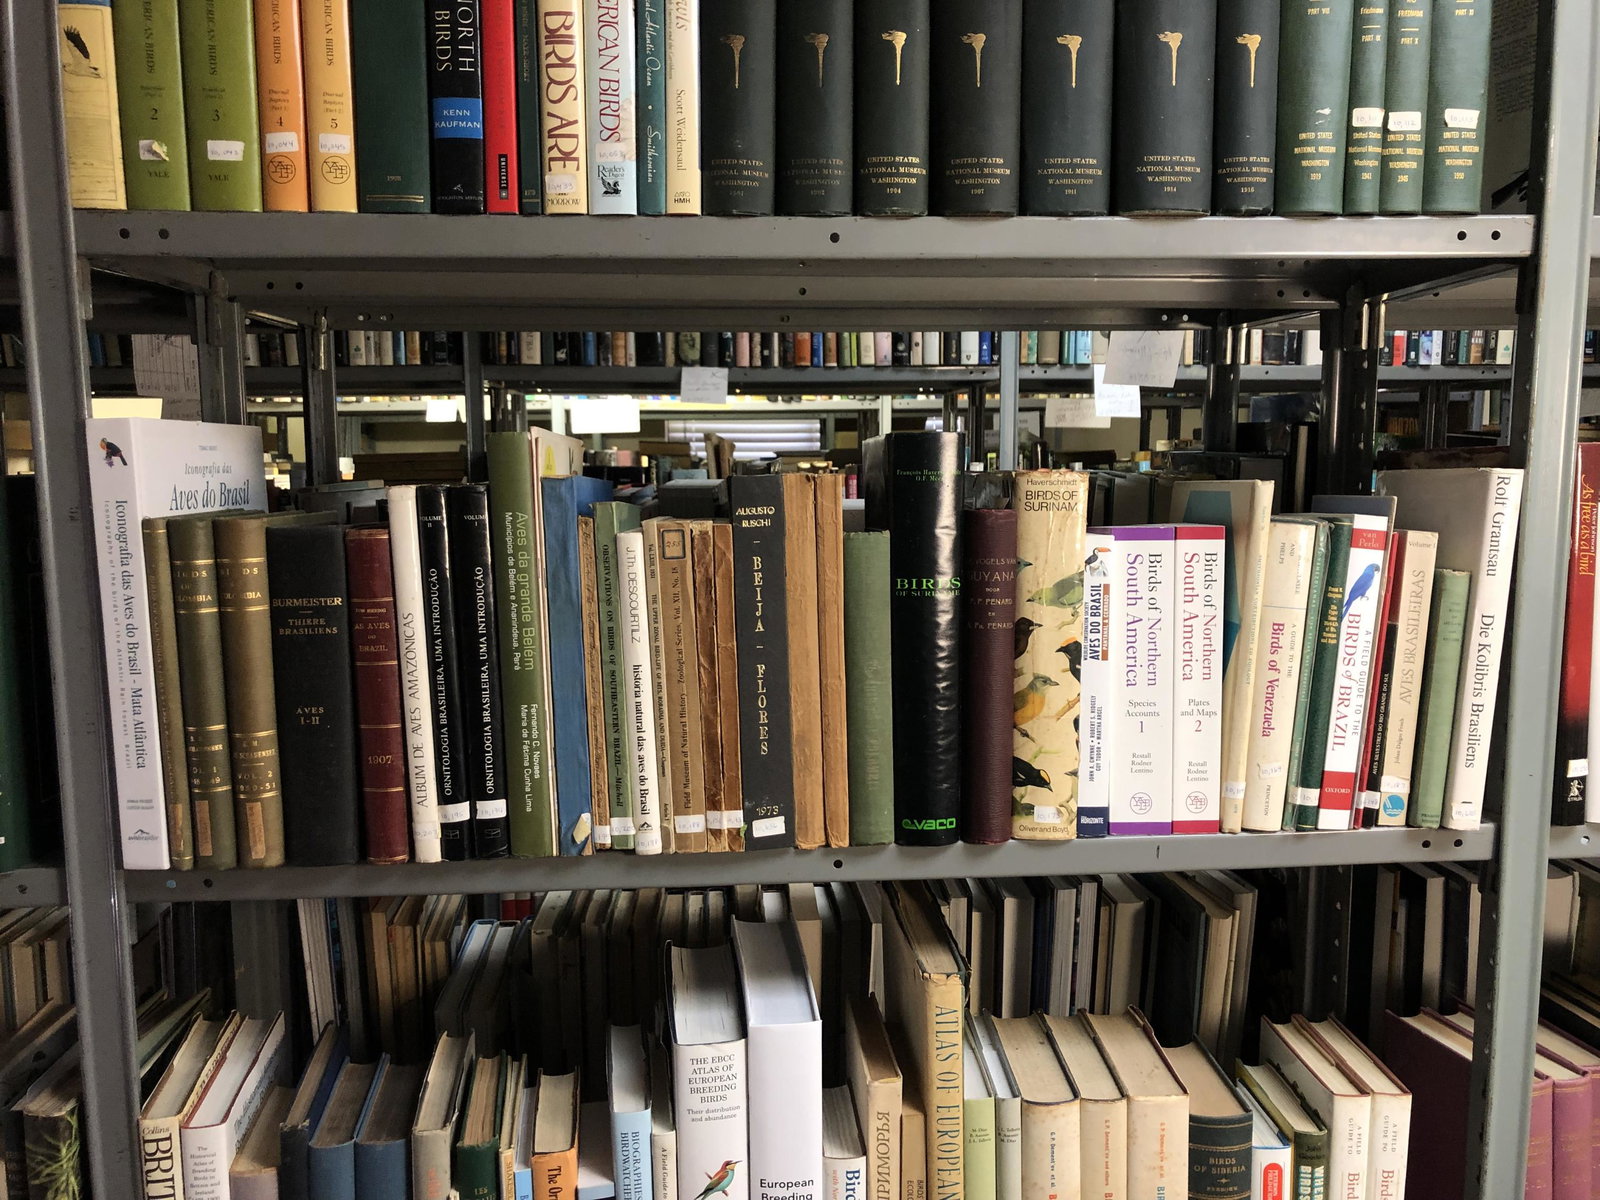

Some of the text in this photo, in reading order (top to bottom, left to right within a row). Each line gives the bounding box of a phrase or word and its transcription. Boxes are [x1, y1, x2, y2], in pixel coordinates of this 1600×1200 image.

[434, 11, 452, 72] BIRDS
[544, 11, 578, 104] BIRDS
[676, 89, 686, 114] Scott
[151, 109, 158, 121] 2
[212, 109, 220, 122] 3
[599, 78, 622, 143] BIRDS
[276, 116, 284, 127] 4
[330, 118, 338, 129] 5
[434, 120, 480, 128] KAUFMAN
[546, 112, 580, 172] ARE
[1299, 132, 1333, 140] UNITED STATES
[867, 156, 920, 164] UNITED STATES
[860, 166, 928, 175] NATIONAL MUSEUM
[673, 196, 690, 204] HMH
[184, 463, 232, 478] Iconografia das
[1026, 478, 1078, 486] Haverschmidt
[1582, 474, 1594, 500] As
[170, 480, 250, 512] Aves do Brasil
[1026, 490, 1078, 500] BIRDS OF
[736, 506, 775, 516] AUGUSTO
[1024, 502, 1078, 512] SURINAM
[1580, 501, 1598, 522] free
[742, 520, 771, 528] RUSCHI
[1581, 524, 1590, 540] as
[1359, 538, 1379, 548] Perlo
[1486, 512, 1505, 576] Grantsau
[1580, 541, 1590, 552] a
[1579, 552, 1595, 576] bird
[896, 578, 962, 590] BIRDS
[516, 512, 536, 671] Aves da grande Belém
[272, 597, 342, 607] BURMEISTER
[627, 572, 641, 644] DESCOURTILZ
[288, 618, 326, 626] THIERE
[1089, 584, 1102, 660] AVES DO BRASIL
[1126, 553, 1144, 688] South America
[1148, 552, 1163, 687] Birds of Northern
[1182, 552, 1200, 682] South America
[1202, 552, 1218, 680] Birds of Northern
[279, 626, 338, 635] BRASILIENS
[1480, 614, 1495, 638] Die
[115, 500, 147, 769] Iconografia das Aves do Brasil Mata Atlântica
[1400, 570, 1425, 704] AVES BRASILEIRAS
[435, 638, 443, 662] UMA
[1362, 640, 1370, 666] FIELD
[1472, 643, 1492, 698] Kolibris
[1262, 622, 1285, 737] Birds of Venezuela
[1332, 613, 1362, 751] BIRDS of BRAZIL
[1356, 672, 1366, 698] GUIDE
[1128, 699, 1156, 708] Species
[1188, 698, 1210, 706] Plates
[296, 706, 324, 714] AVES
[1125, 710, 1160, 718] Accounts
[1196, 709, 1218, 718] Maps
[1354, 704, 1362, 715] TO
[410, 706, 422, 736] AVES
[530, 704, 540, 738] Fernando
[1139, 720, 1144, 732] 1
[1194, 720, 1202, 732] 2
[1352, 720, 1360, 736] THE
[633, 664, 650, 816] história natural das aves do Brasil
[1464, 704, 1484, 768] Brasiliens
[414, 742, 424, 760] DE
[368, 755, 392, 764] 1907
[440, 729, 452, 796] ORNITOLOGIA
[416, 764, 428, 808] ALBUM
[756, 805, 779, 816] 1973
[1019, 824, 1038, 832] Oliver
[1052, 825, 1069, 835] Boyd
[936, 1006, 959, 1062] ATLAS
[690, 1054, 735, 1066] THE EBCC
[691, 1064, 734, 1076] ATLAS OF
[688, 1073, 738, 1085] EUROPEAN
[936, 1071, 960, 1094] OF
[690, 1083, 737, 1094] BREEDING
[700, 1094, 728, 1104] BIRDS
[705, 1104, 740, 1114] distribution
[704, 1113, 736, 1121] abundance
[142, 1126, 170, 1136] Collins
[1212, 1165, 1246, 1174] SIBERIA
[760, 1178, 814, 1190] European
